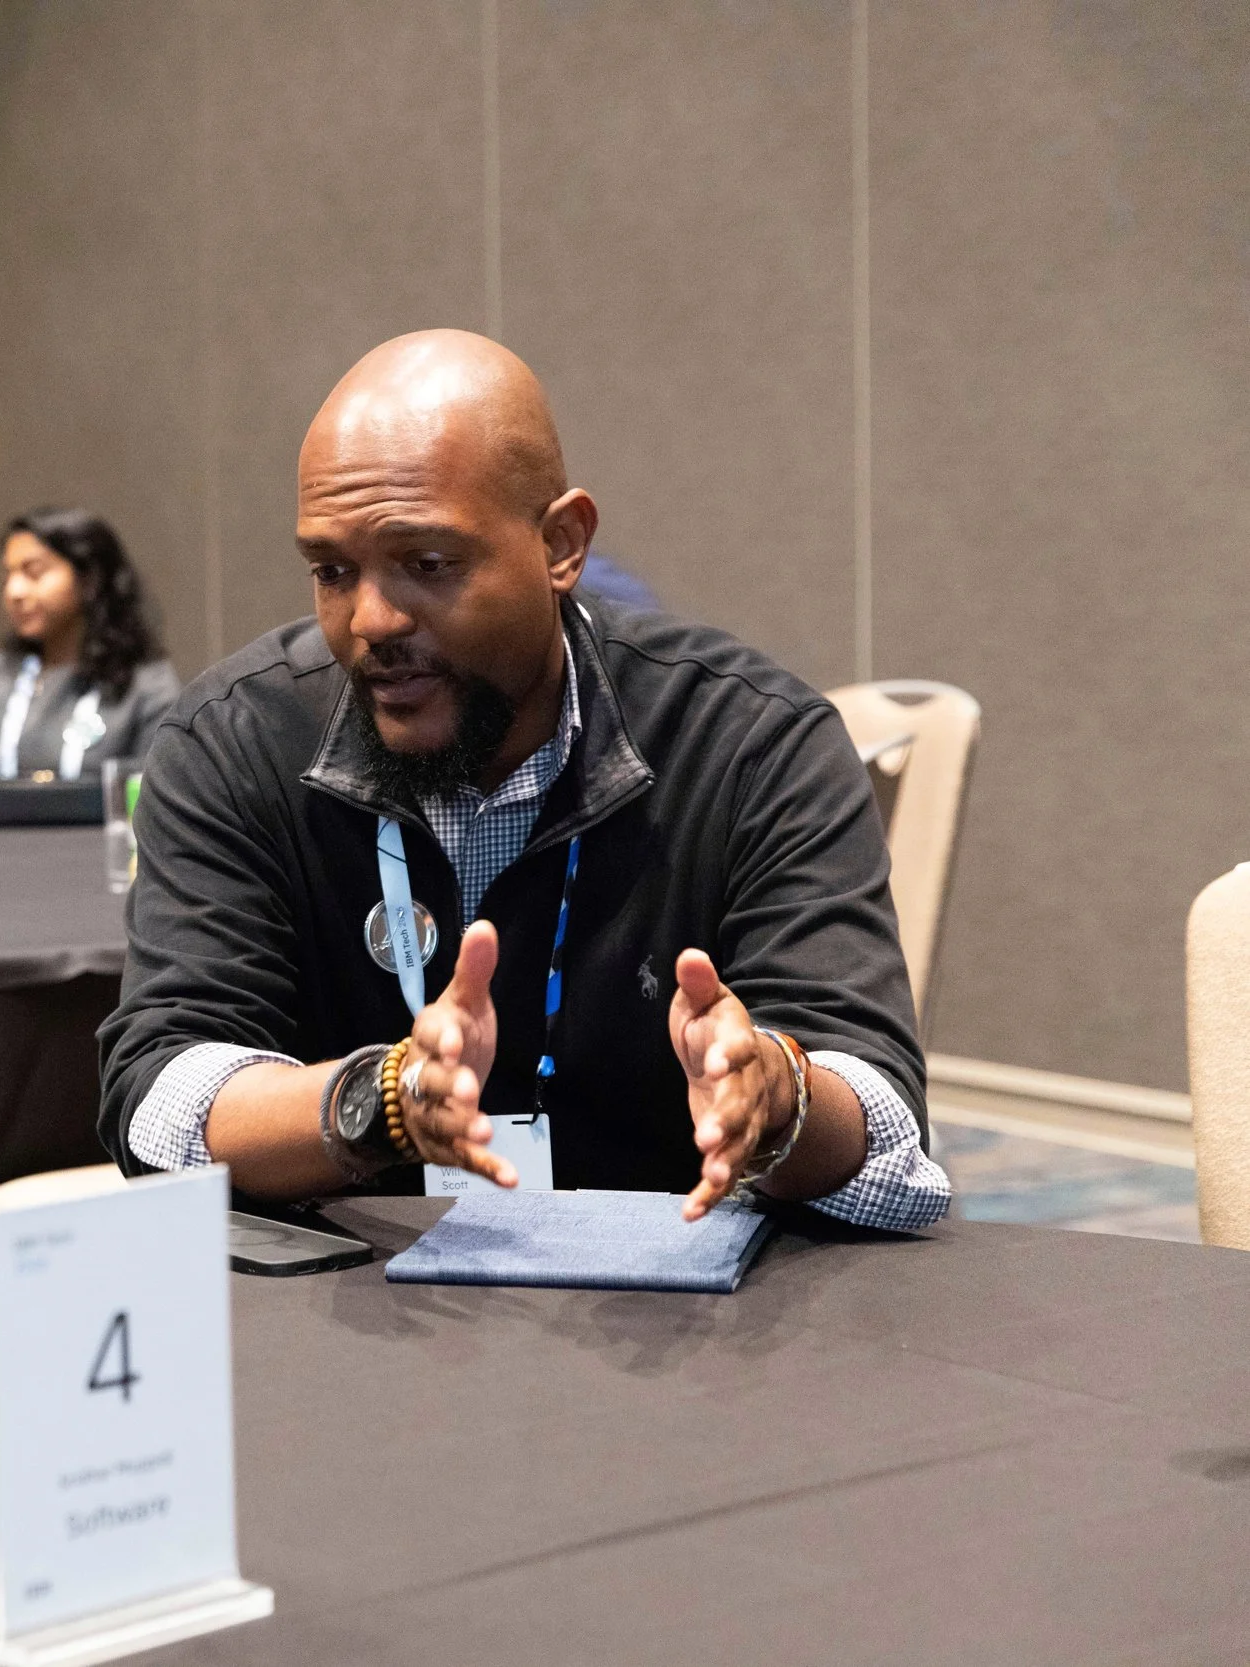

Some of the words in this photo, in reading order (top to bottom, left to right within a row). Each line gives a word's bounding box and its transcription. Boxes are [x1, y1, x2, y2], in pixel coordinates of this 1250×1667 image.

[401, 929, 411, 950] Tech
[404, 950, 414, 968] IBM
[442, 1181, 468, 1190] Scott
[85, 1306, 142, 1404] 4
[65, 1493, 170, 1540] Software
